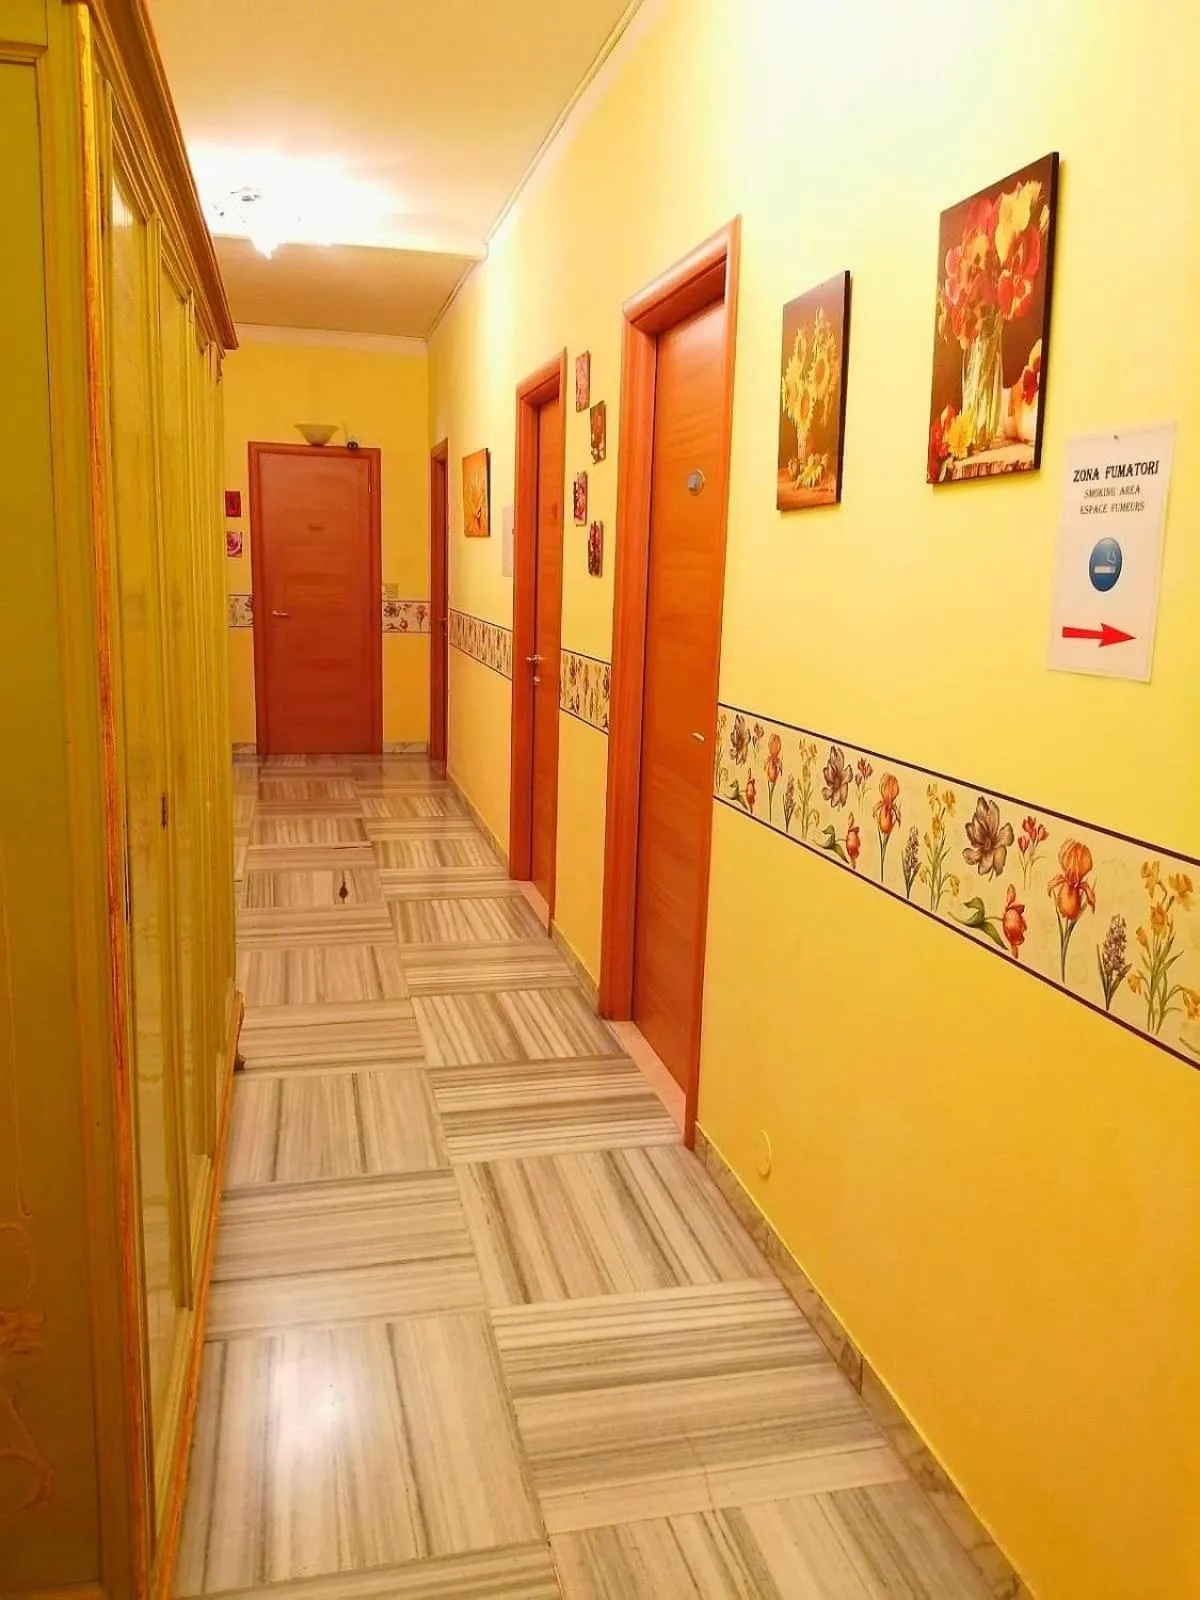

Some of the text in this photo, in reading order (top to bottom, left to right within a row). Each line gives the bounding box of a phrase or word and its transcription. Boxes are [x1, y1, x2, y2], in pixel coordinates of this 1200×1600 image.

[1073, 460, 1160, 483] ZONA FUMATORI
[1084, 484, 1140, 498] SMOKING AREA
[1080, 501, 1145, 515] ESPACE FUMEURS
